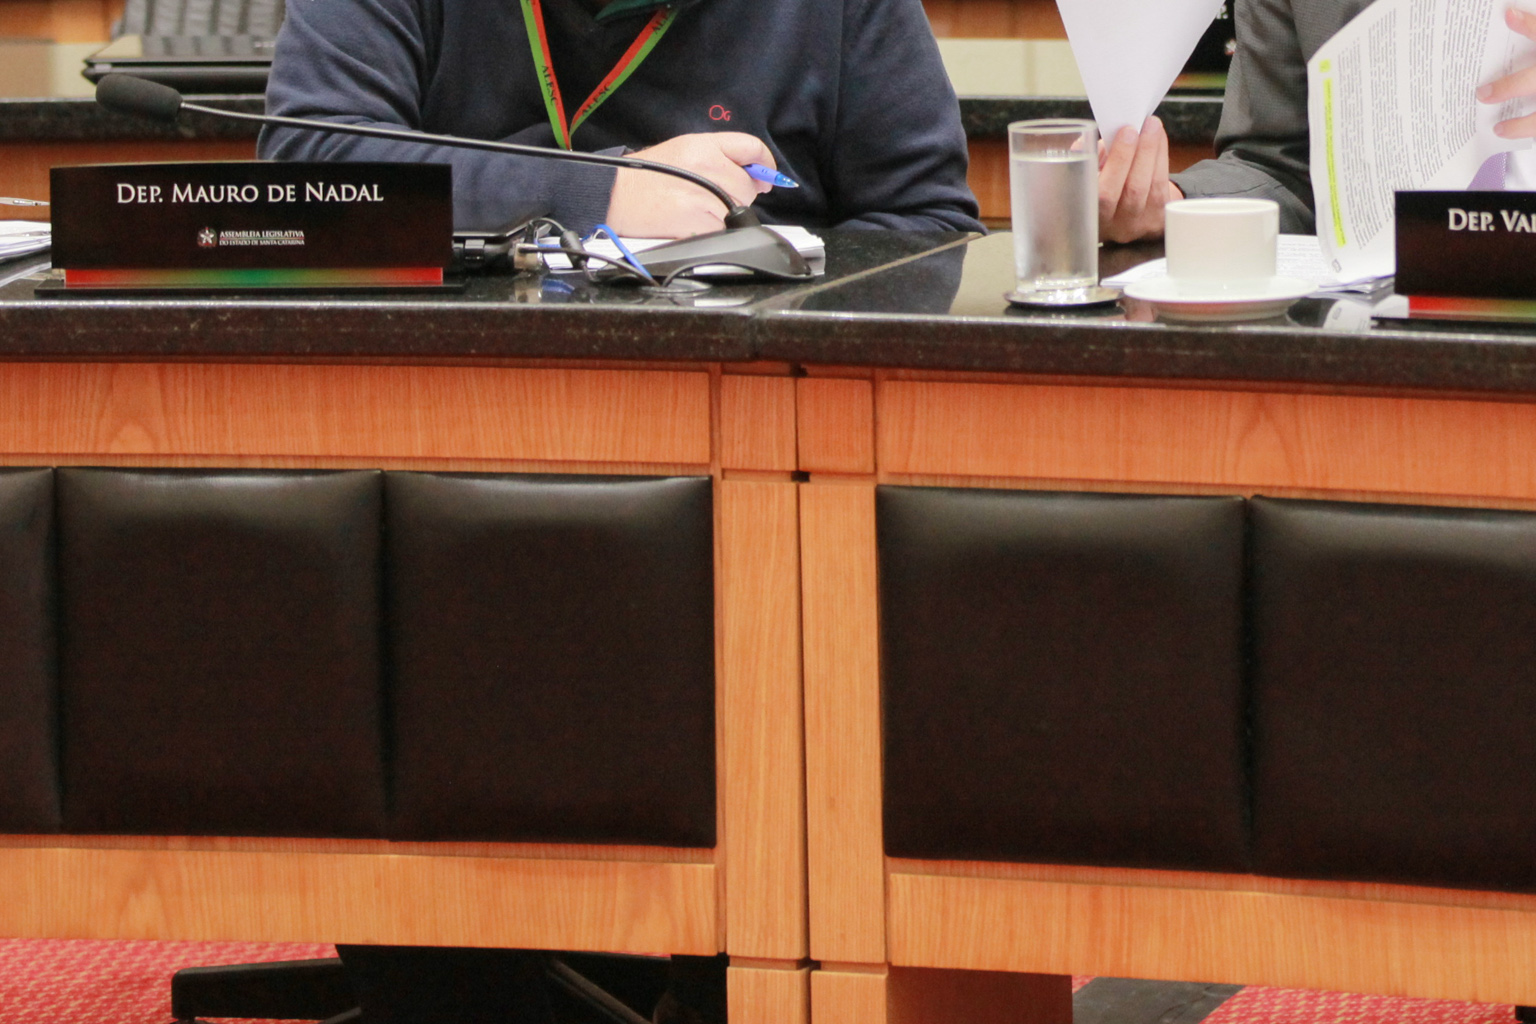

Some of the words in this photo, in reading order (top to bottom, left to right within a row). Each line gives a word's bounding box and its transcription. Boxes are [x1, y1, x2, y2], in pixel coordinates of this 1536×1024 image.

[541, 65, 559, 106] ALESC
[117, 183, 163, 204] DEP.
[171, 183, 259, 204] MAURO
[267, 184, 296, 203] DE
[305, 182, 384, 203] NADAL
[1448, 208, 1495, 232] DEP.
[220, 230, 260, 238] ASSEMBLEIA
[262, 230, 305, 238] LEGISLATIVA
